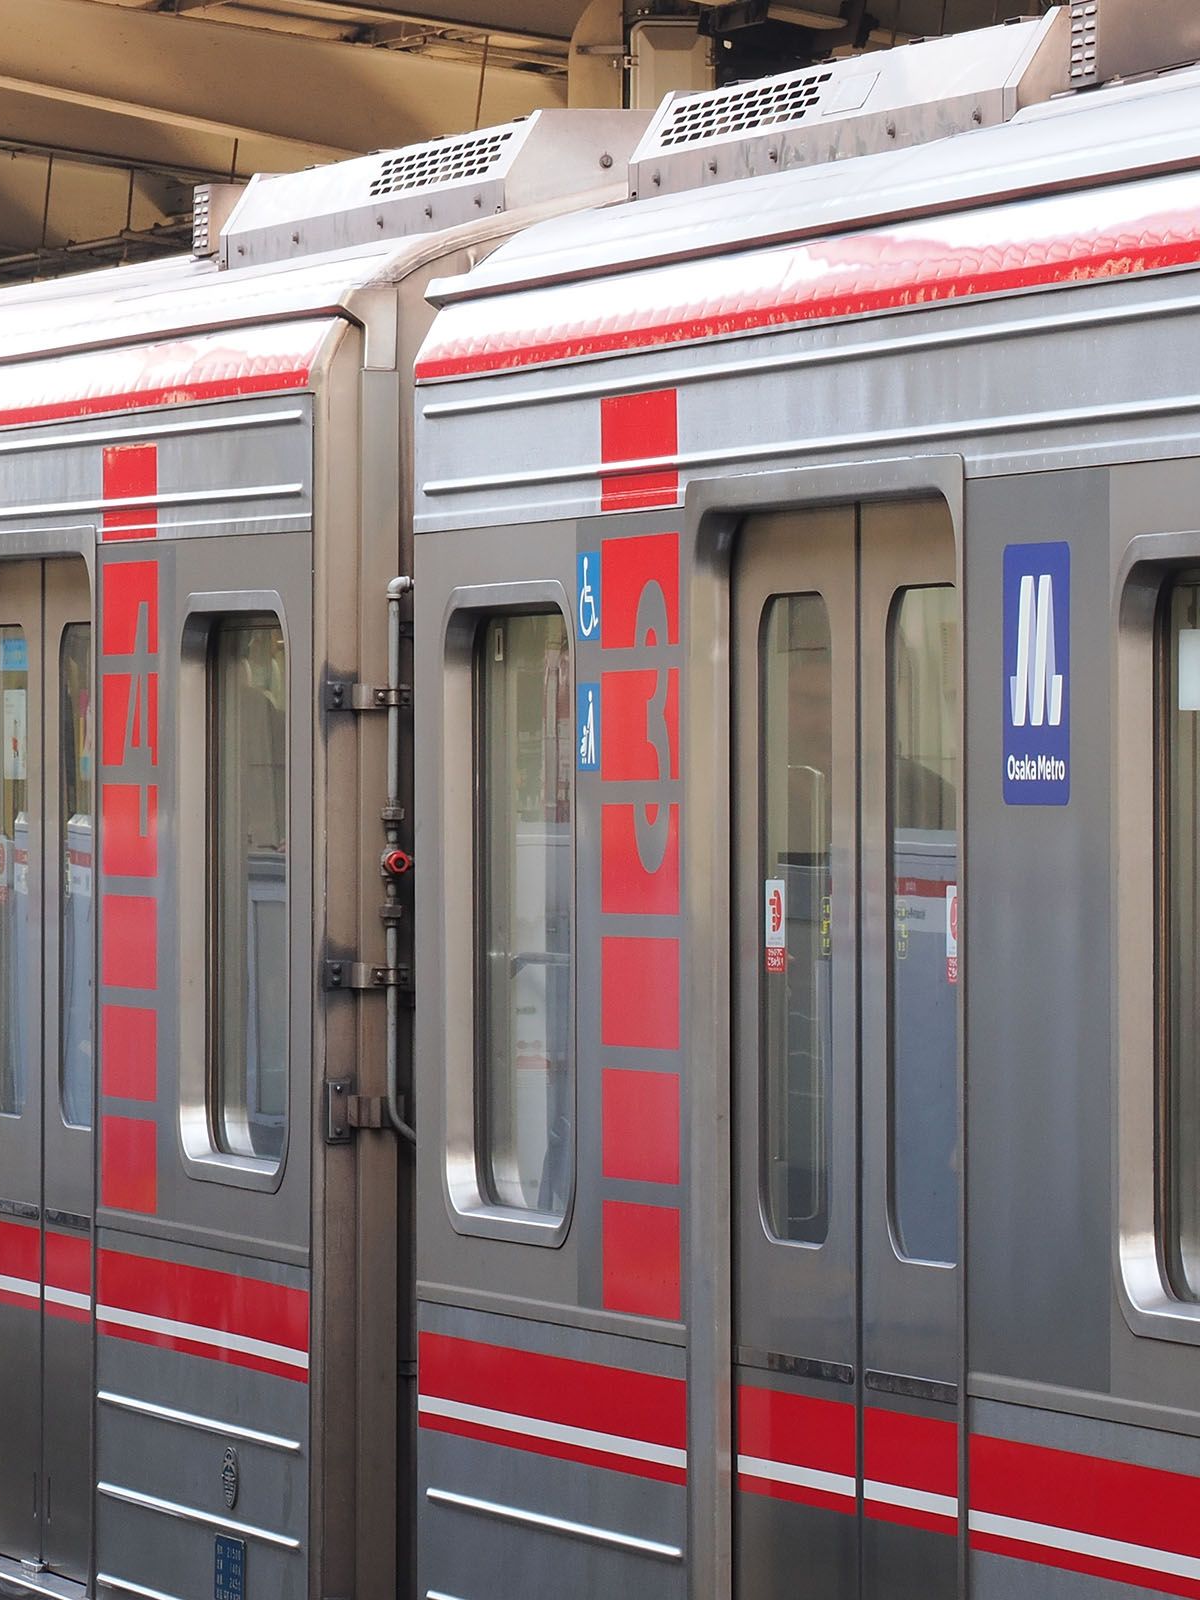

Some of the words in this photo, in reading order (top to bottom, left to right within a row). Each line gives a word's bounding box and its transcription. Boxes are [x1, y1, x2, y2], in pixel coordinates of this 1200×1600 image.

[121, 601, 153, 838] 4
[633, 579, 671, 874] 3
[1007, 753, 1037, 781] Osaka
[1037, 753, 1065, 781] Metro
